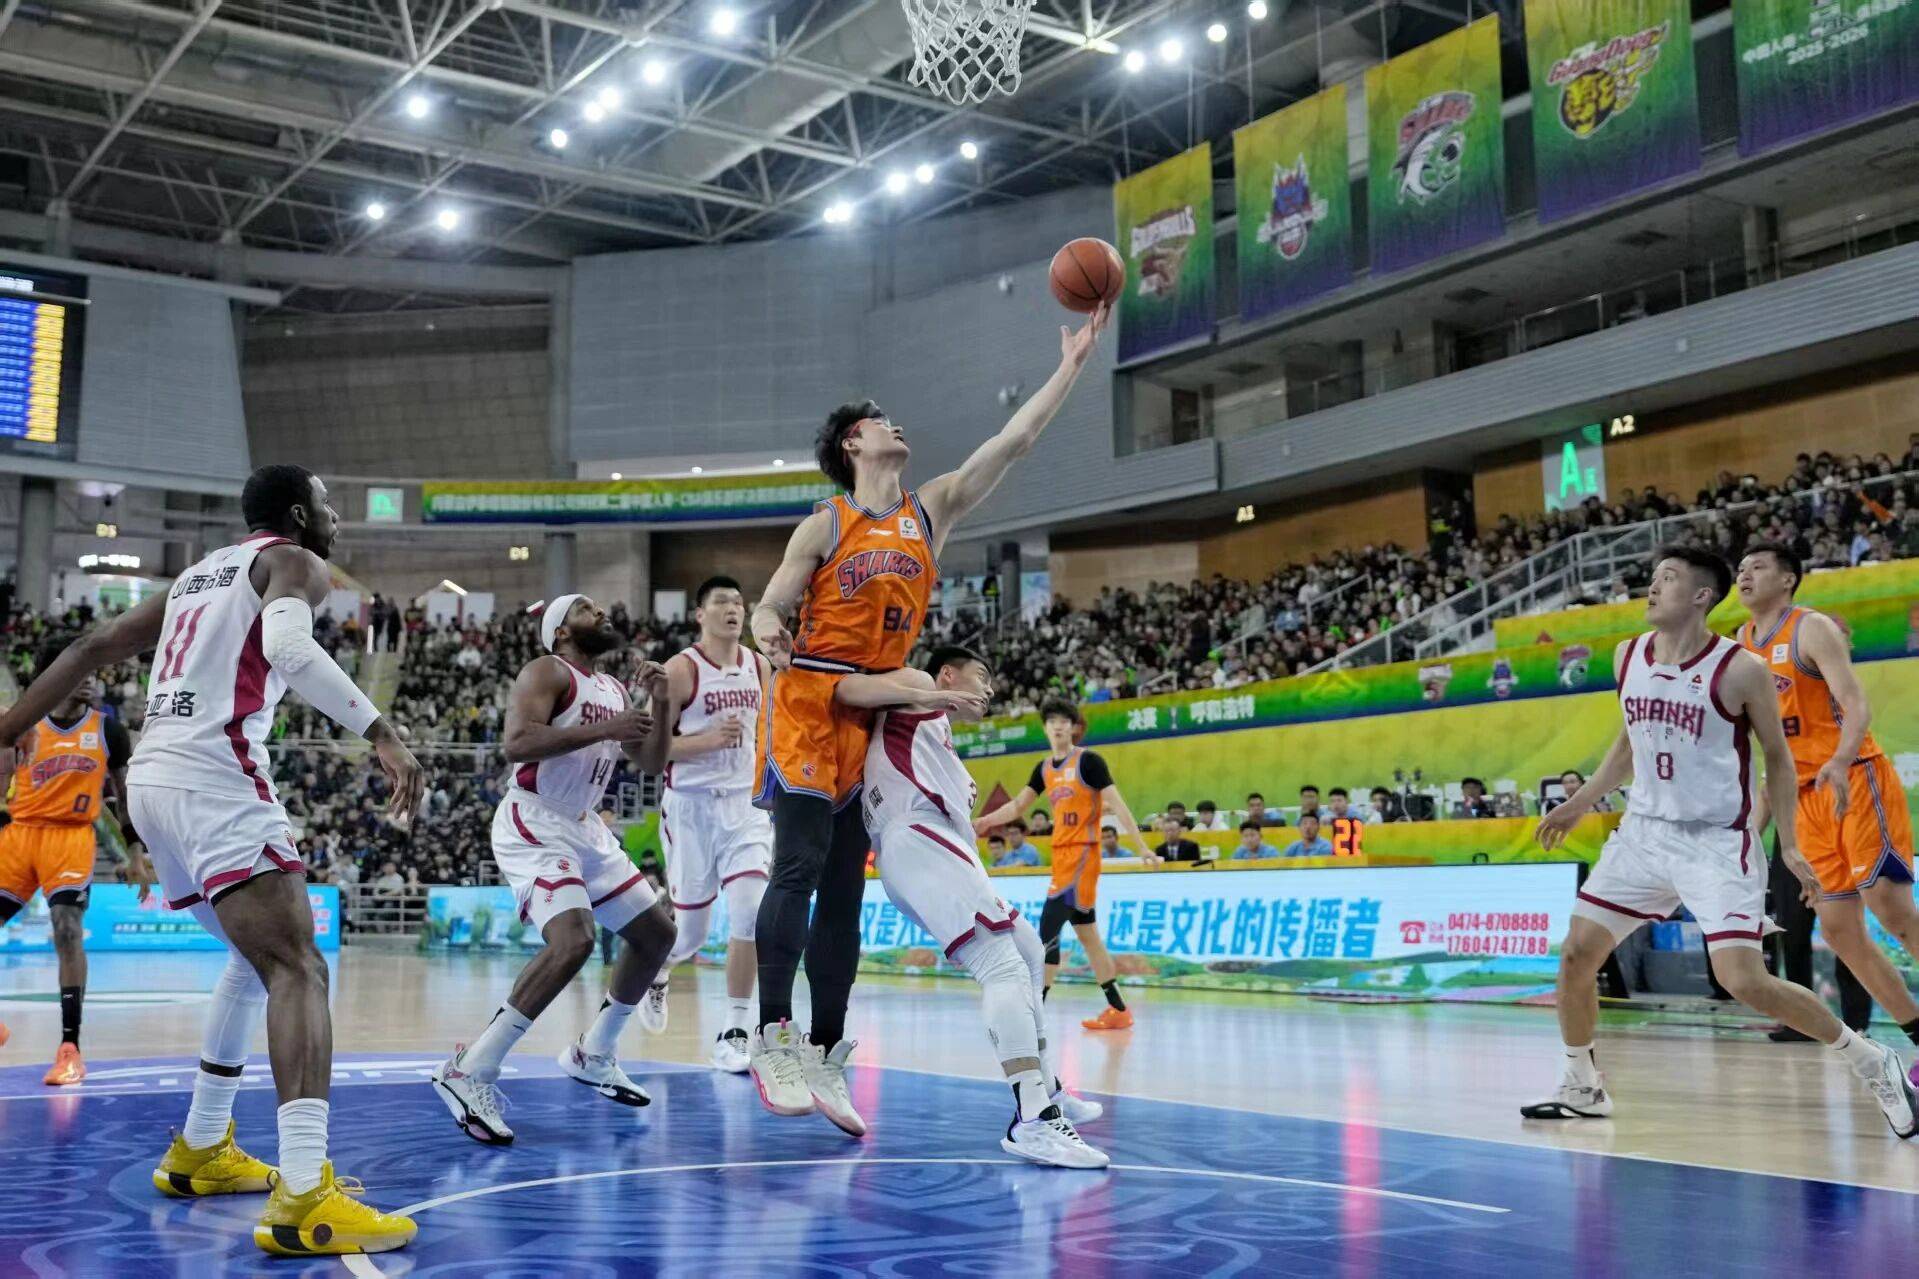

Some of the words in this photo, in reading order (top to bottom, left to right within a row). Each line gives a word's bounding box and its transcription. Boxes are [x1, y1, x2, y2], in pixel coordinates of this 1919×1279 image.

[1610, 415, 1635, 436] A2
[1236, 504, 1255, 522] A1
[837, 550, 924, 598] SHARKS
[884, 606, 913, 632] 94
[1624, 696, 1706, 742] SHANXI
[1656, 752, 1674, 780] 8
[73, 794, 91, 813] 0
[1063, 811, 1078, 826] 10
[1106, 897, 1382, 957] 还是文化的传播者
[1448, 913, 1549, 931] 0474-8708888
[1447, 935, 1548, 955] 17604747788
